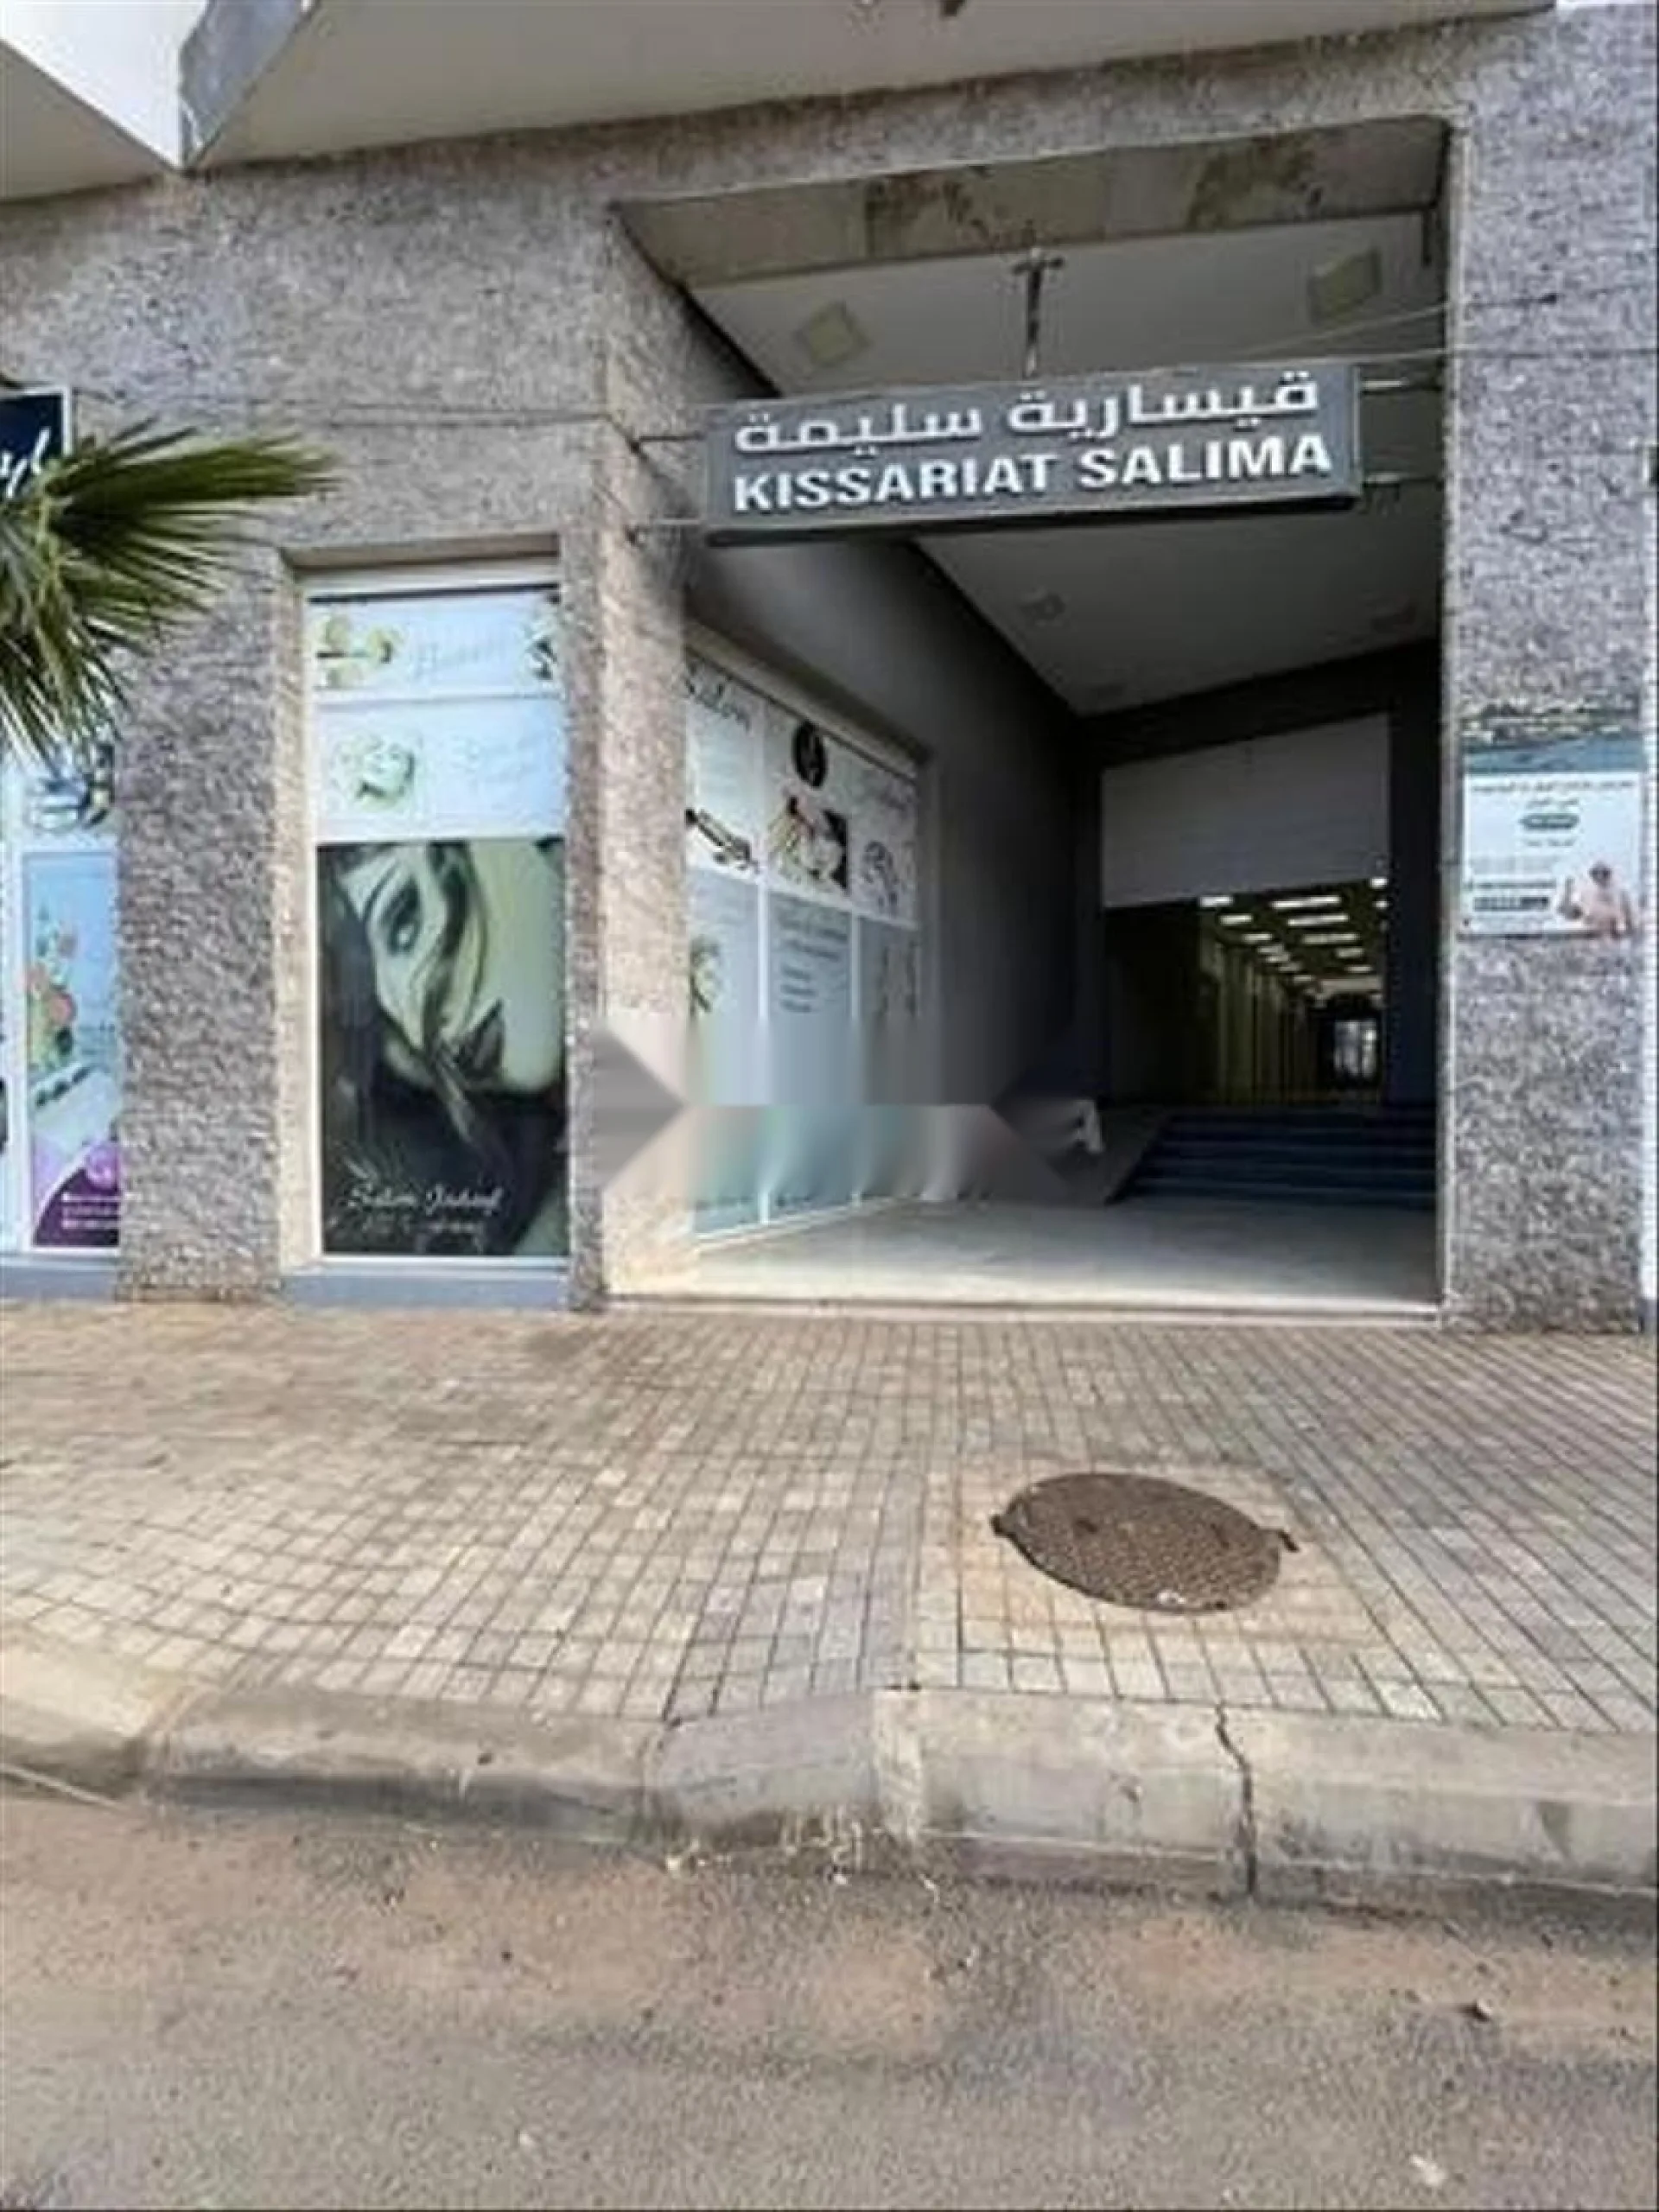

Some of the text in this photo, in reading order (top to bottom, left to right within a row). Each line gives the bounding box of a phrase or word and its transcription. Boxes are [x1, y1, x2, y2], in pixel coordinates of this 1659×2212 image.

[734, 370, 1319, 457] قيسارية سليمة
[734, 435, 1332, 512] KISSARIAT SALIMA
